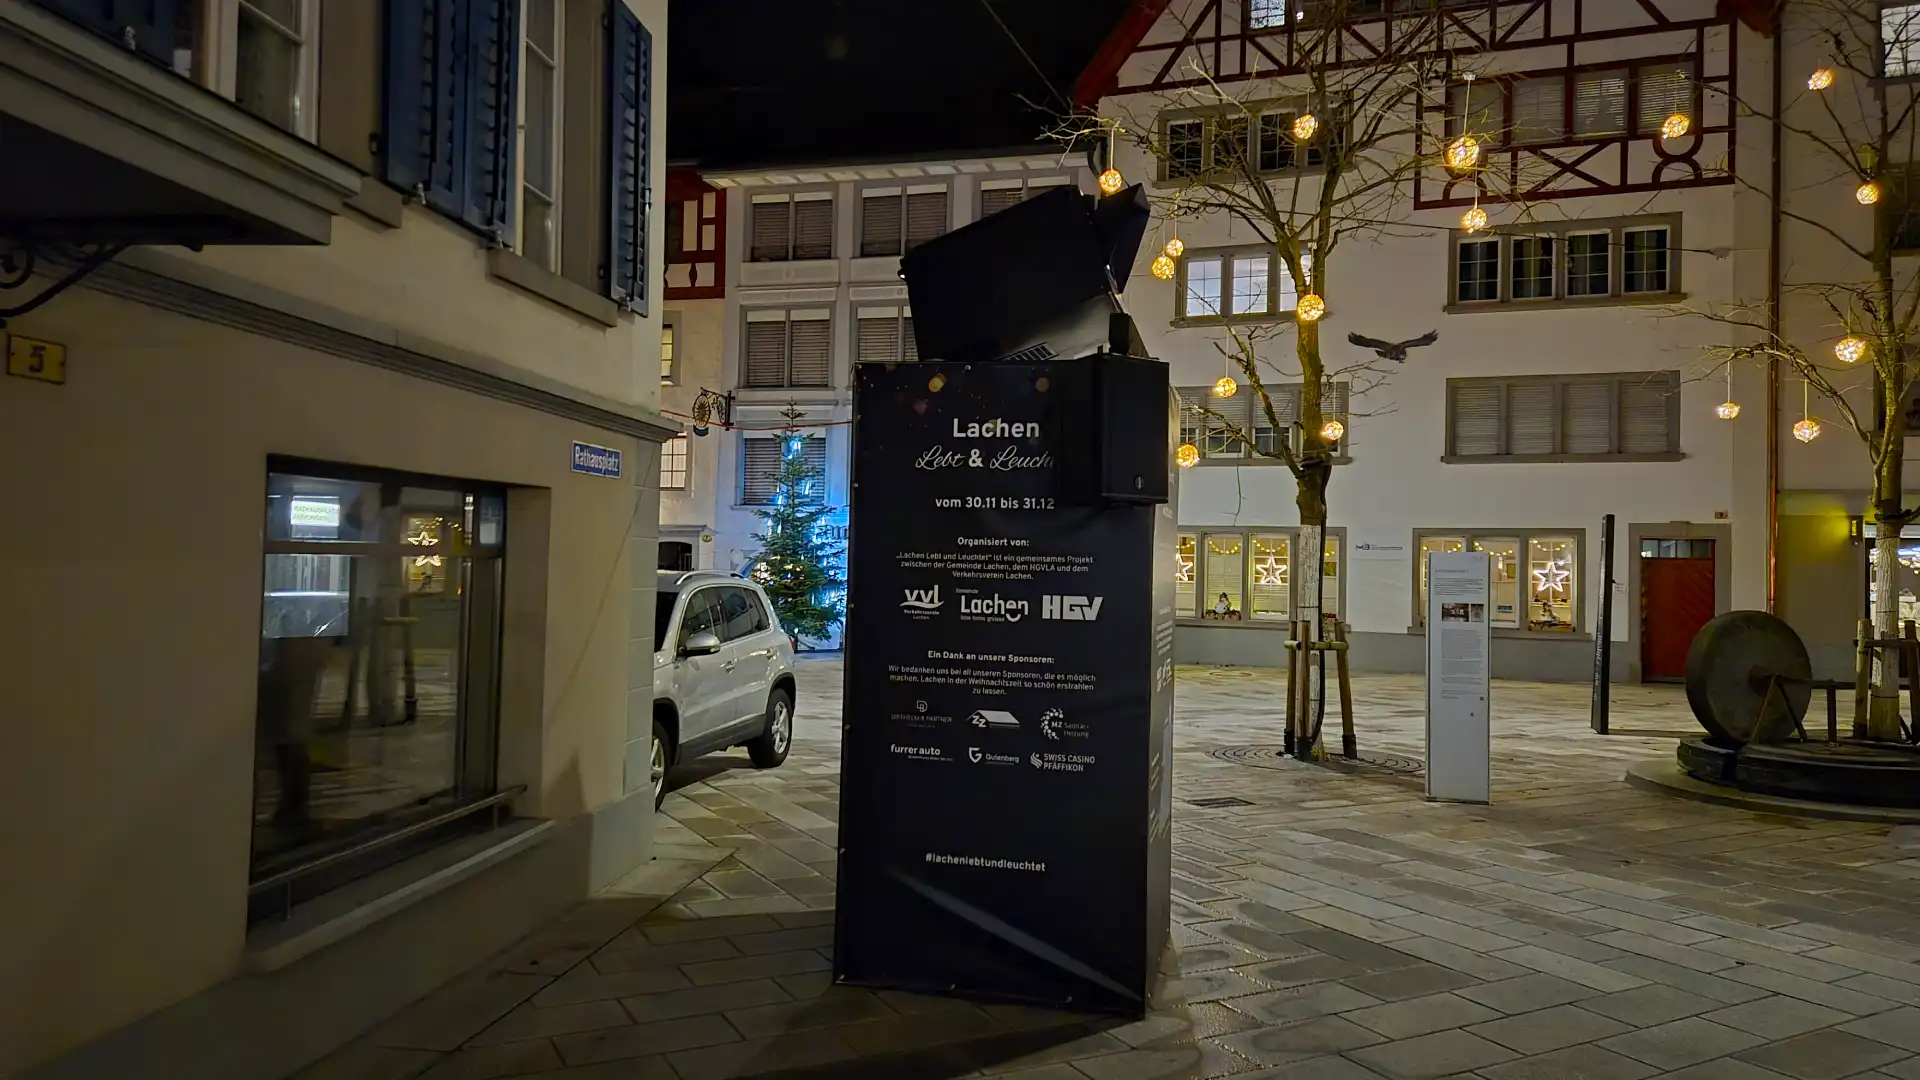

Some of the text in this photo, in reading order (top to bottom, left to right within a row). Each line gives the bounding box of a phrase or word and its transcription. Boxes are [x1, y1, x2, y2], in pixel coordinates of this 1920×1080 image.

[28, 345, 47, 373] 5
[953, 418, 1040, 438] Lachen
[575, 446, 619, 475] Rathausplatz
[915, 445, 1054, 471] Lebt & Leuch
[935, 496, 1055, 510] vom 30.11 bis 31.12
[957, 536, 1030, 547] Organisiert von:
[926, 552, 942, 560] Lebt
[1003, 554, 1015, 562] ein
[1016, 555, 1066, 563] gemeinsames
[1067, 556, 1094, 565] Projekt
[946, 561, 982, 569] Gemeinde
[983, 562, 1011, 571] Lachen,
[1012, 563, 1028, 571] dem
[1029, 564, 1055, 572] HGVLA
[952, 570, 1034, 580] Verkehrsverein Lachen.
[904, 584, 939, 604] vvl
[960, 593, 1029, 616] Lachen
[1042, 594, 1104, 620] HGV
[927, 650, 1055, 664] Ein Dank an unsere Sponsoren:
[888, 664, 1096, 682] Wir bedanken uns bei all unseren Sponsoren, die es möglich
[920, 675, 946, 683] Lachen
[947, 676, 954, 684] in
[955, 677, 967, 685] der
[968, 677, 1022, 688] Weihnachtszeit
[1033, 681, 1056, 690] schön
[1056, 682, 1094, 691] erstrahlen
[982, 686, 1007, 695] lassen.
[891, 743, 941, 755] furrer auto
[1043, 753, 1096, 764] SWISS CASINO
[925, 852, 1046, 872] #lachenlebtundleuchtet
